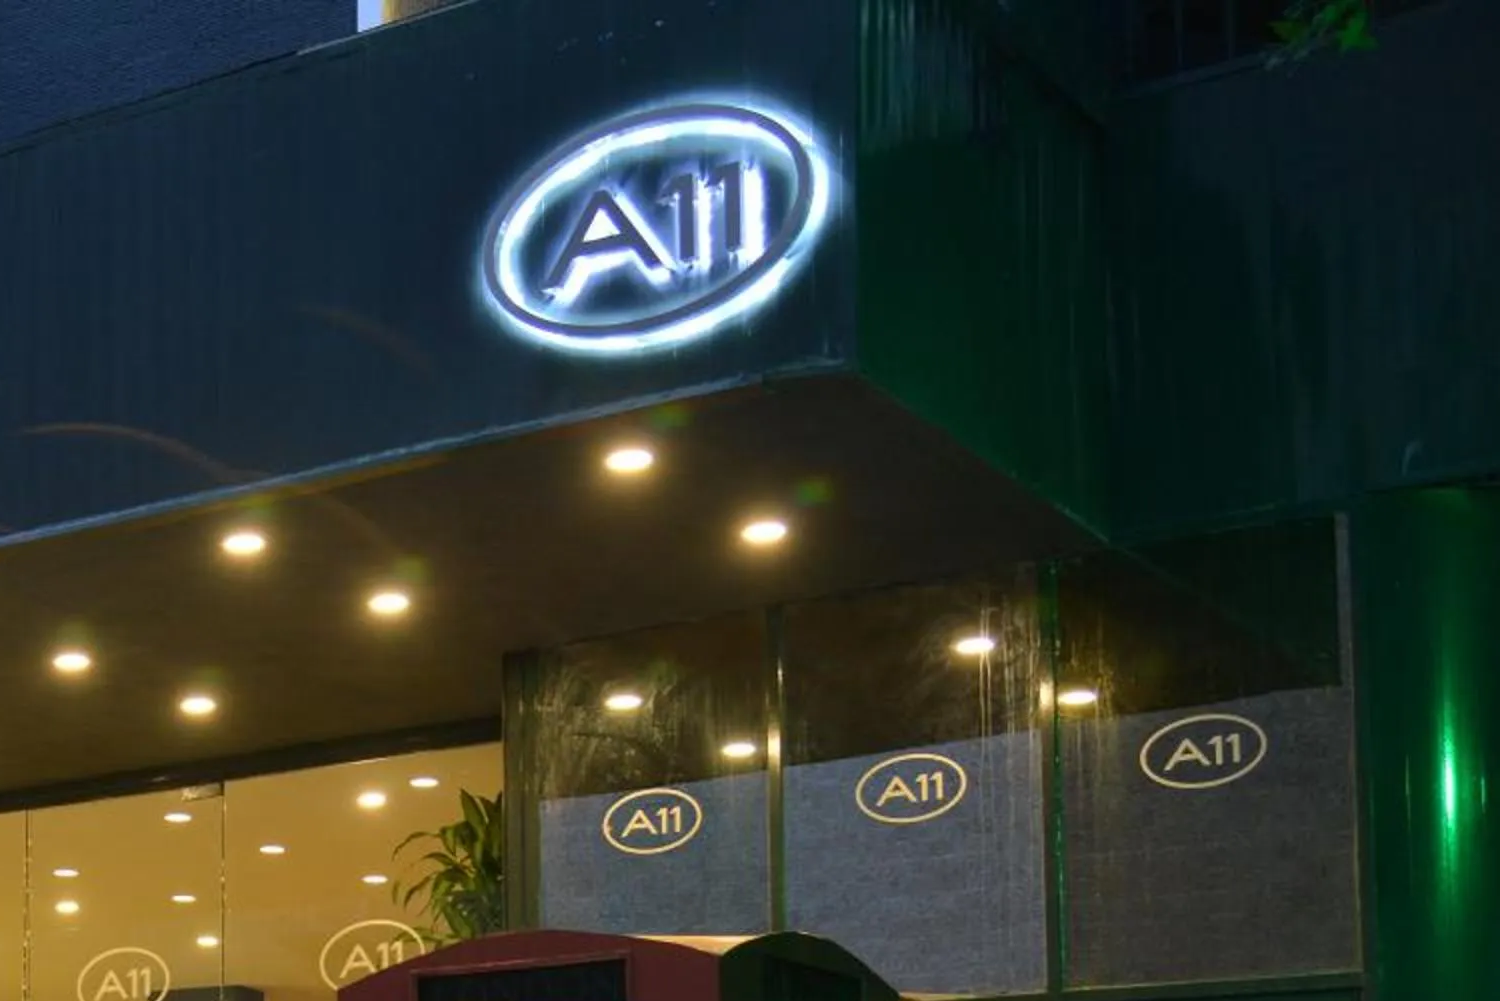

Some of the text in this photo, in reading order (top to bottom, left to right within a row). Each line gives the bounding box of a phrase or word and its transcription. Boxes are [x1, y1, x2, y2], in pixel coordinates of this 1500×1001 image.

[540, 158, 748, 291] A11
[1163, 732, 1242, 772] A11
[875, 771, 944, 808] A11
[620, 805, 683, 838] A11
[338, 938, 404, 979] A11
[94, 965, 153, 1001] A11
